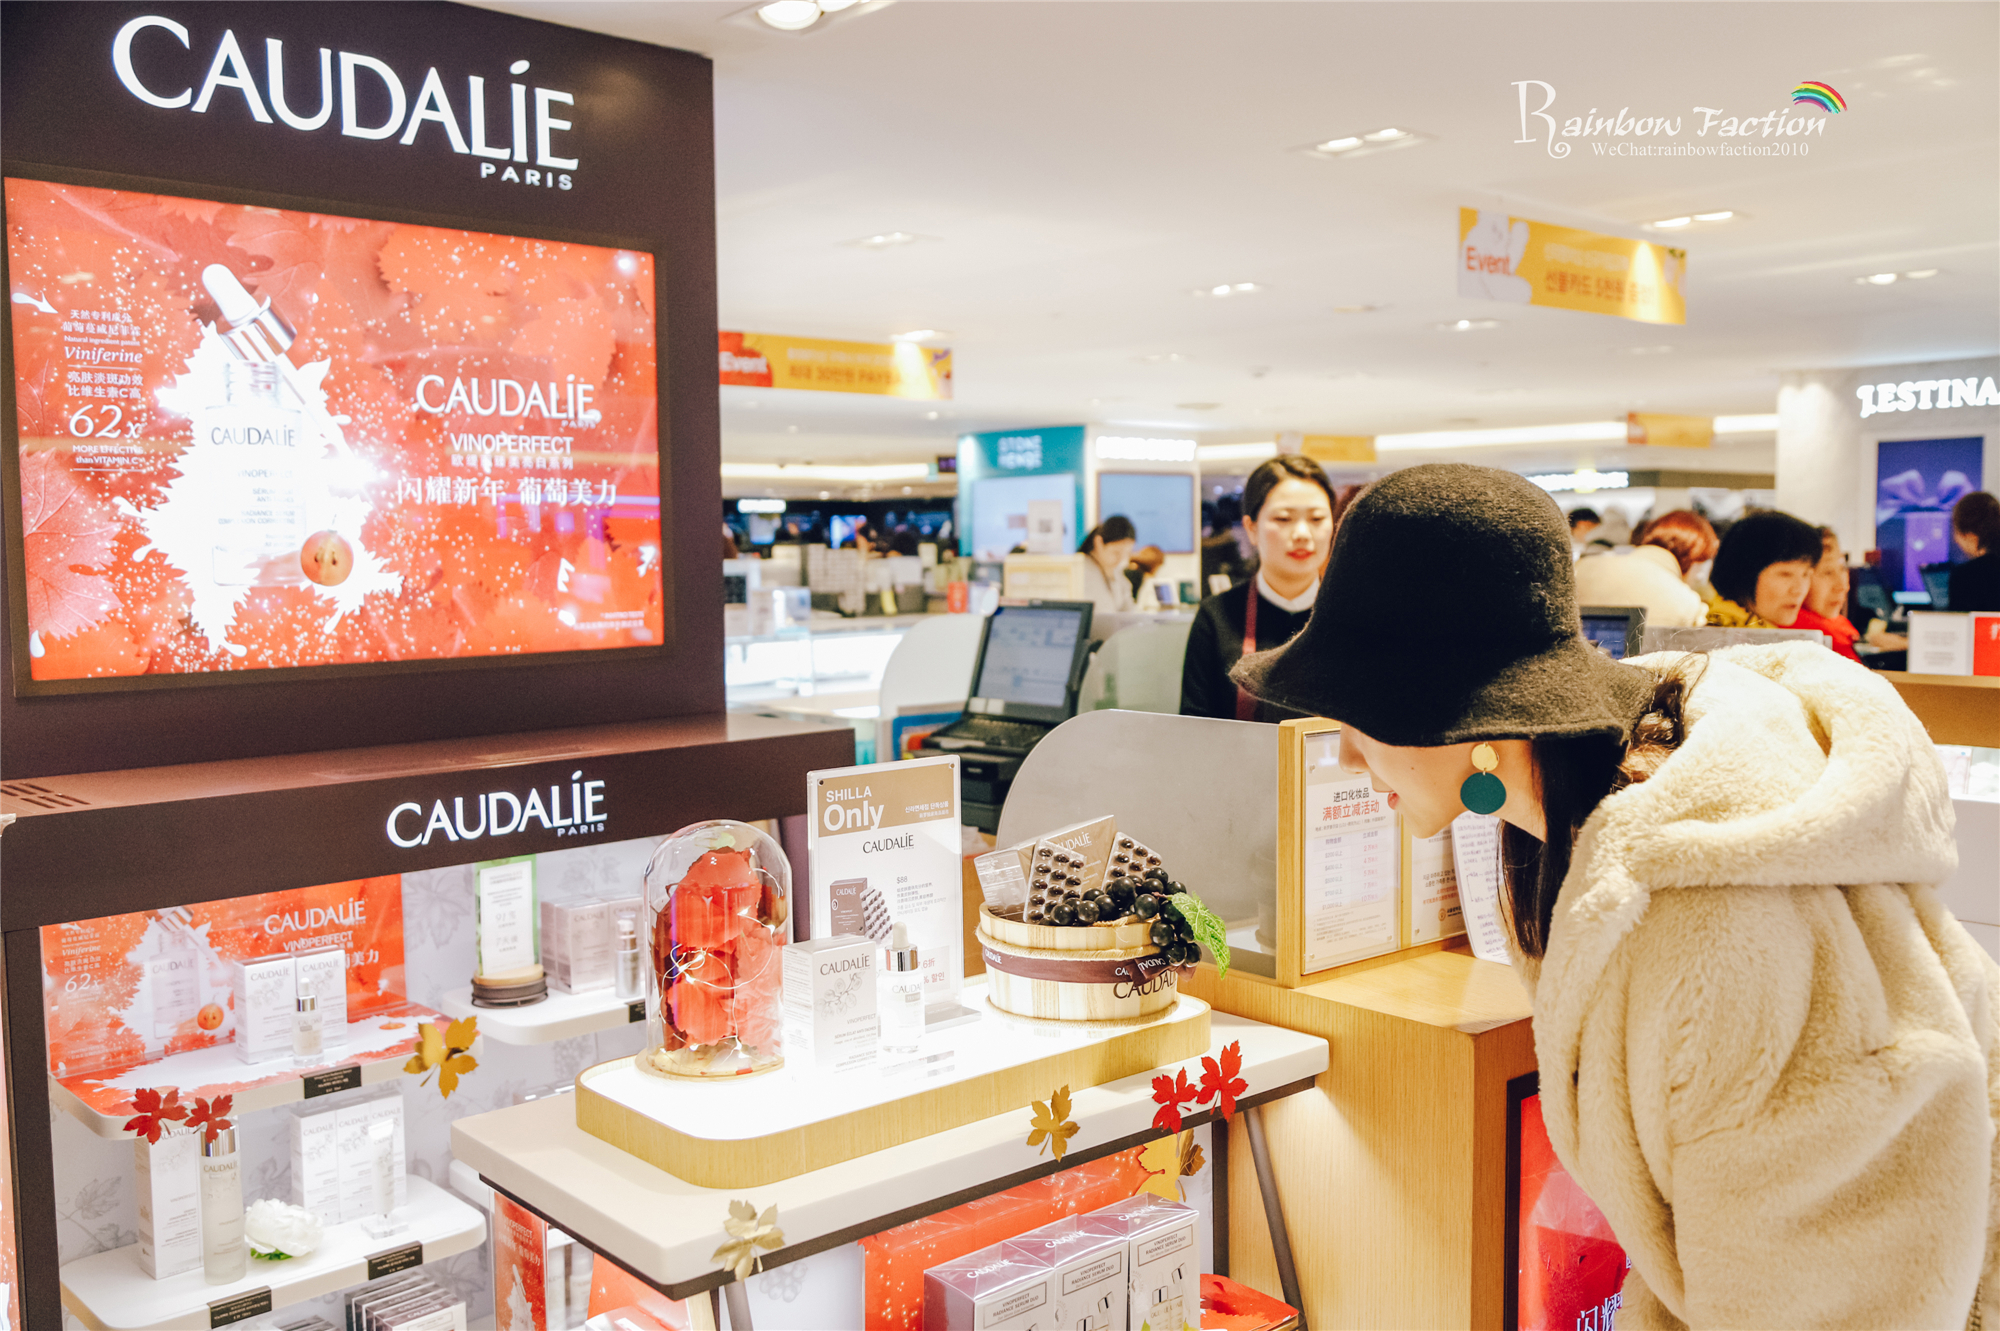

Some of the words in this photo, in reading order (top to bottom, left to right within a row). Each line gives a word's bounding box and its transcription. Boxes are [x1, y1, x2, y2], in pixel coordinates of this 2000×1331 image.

[480, 162, 573, 191] PARIS
[1466, 246, 1511, 276] Event
[64, 346, 144, 364] Viniferine
[72, 445, 99, 453] MORE
[450, 432, 574, 455] VINOPERFECT
[397, 476, 507, 506] 闪耀新年
[516, 476, 617, 507] 葡萄美力
[826, 785, 873, 803] SHILLA
[1333, 787, 1370, 803] 进口化妆品
[823, 800, 885, 831] Only
[1322, 799, 1380, 822] 满额立减活动
[557, 822, 605, 837] PARIS
[283, 930, 354, 952] VINOPERFECT
[847, 1013, 876, 1025] VINOPERFECT
[1153, 1233, 1178, 1246] VINOPERFECT
[1145, 1243, 1165, 1255] RADIANCE
[1071, 1273, 1091, 1285] RADIANCE
[1091, 1267, 1106, 1277] SERUM
[1105, 1264, 1115, 1272] DUO
[1080, 1261, 1106, 1276] VINOPERFECT
[992, 1303, 1014, 1317] RADIANCE
[1014, 1298, 1030, 1308] SERUM
[1029, 1294, 1039, 1303] DUO
[1002, 1292, 1030, 1307] VINOPERFECT
